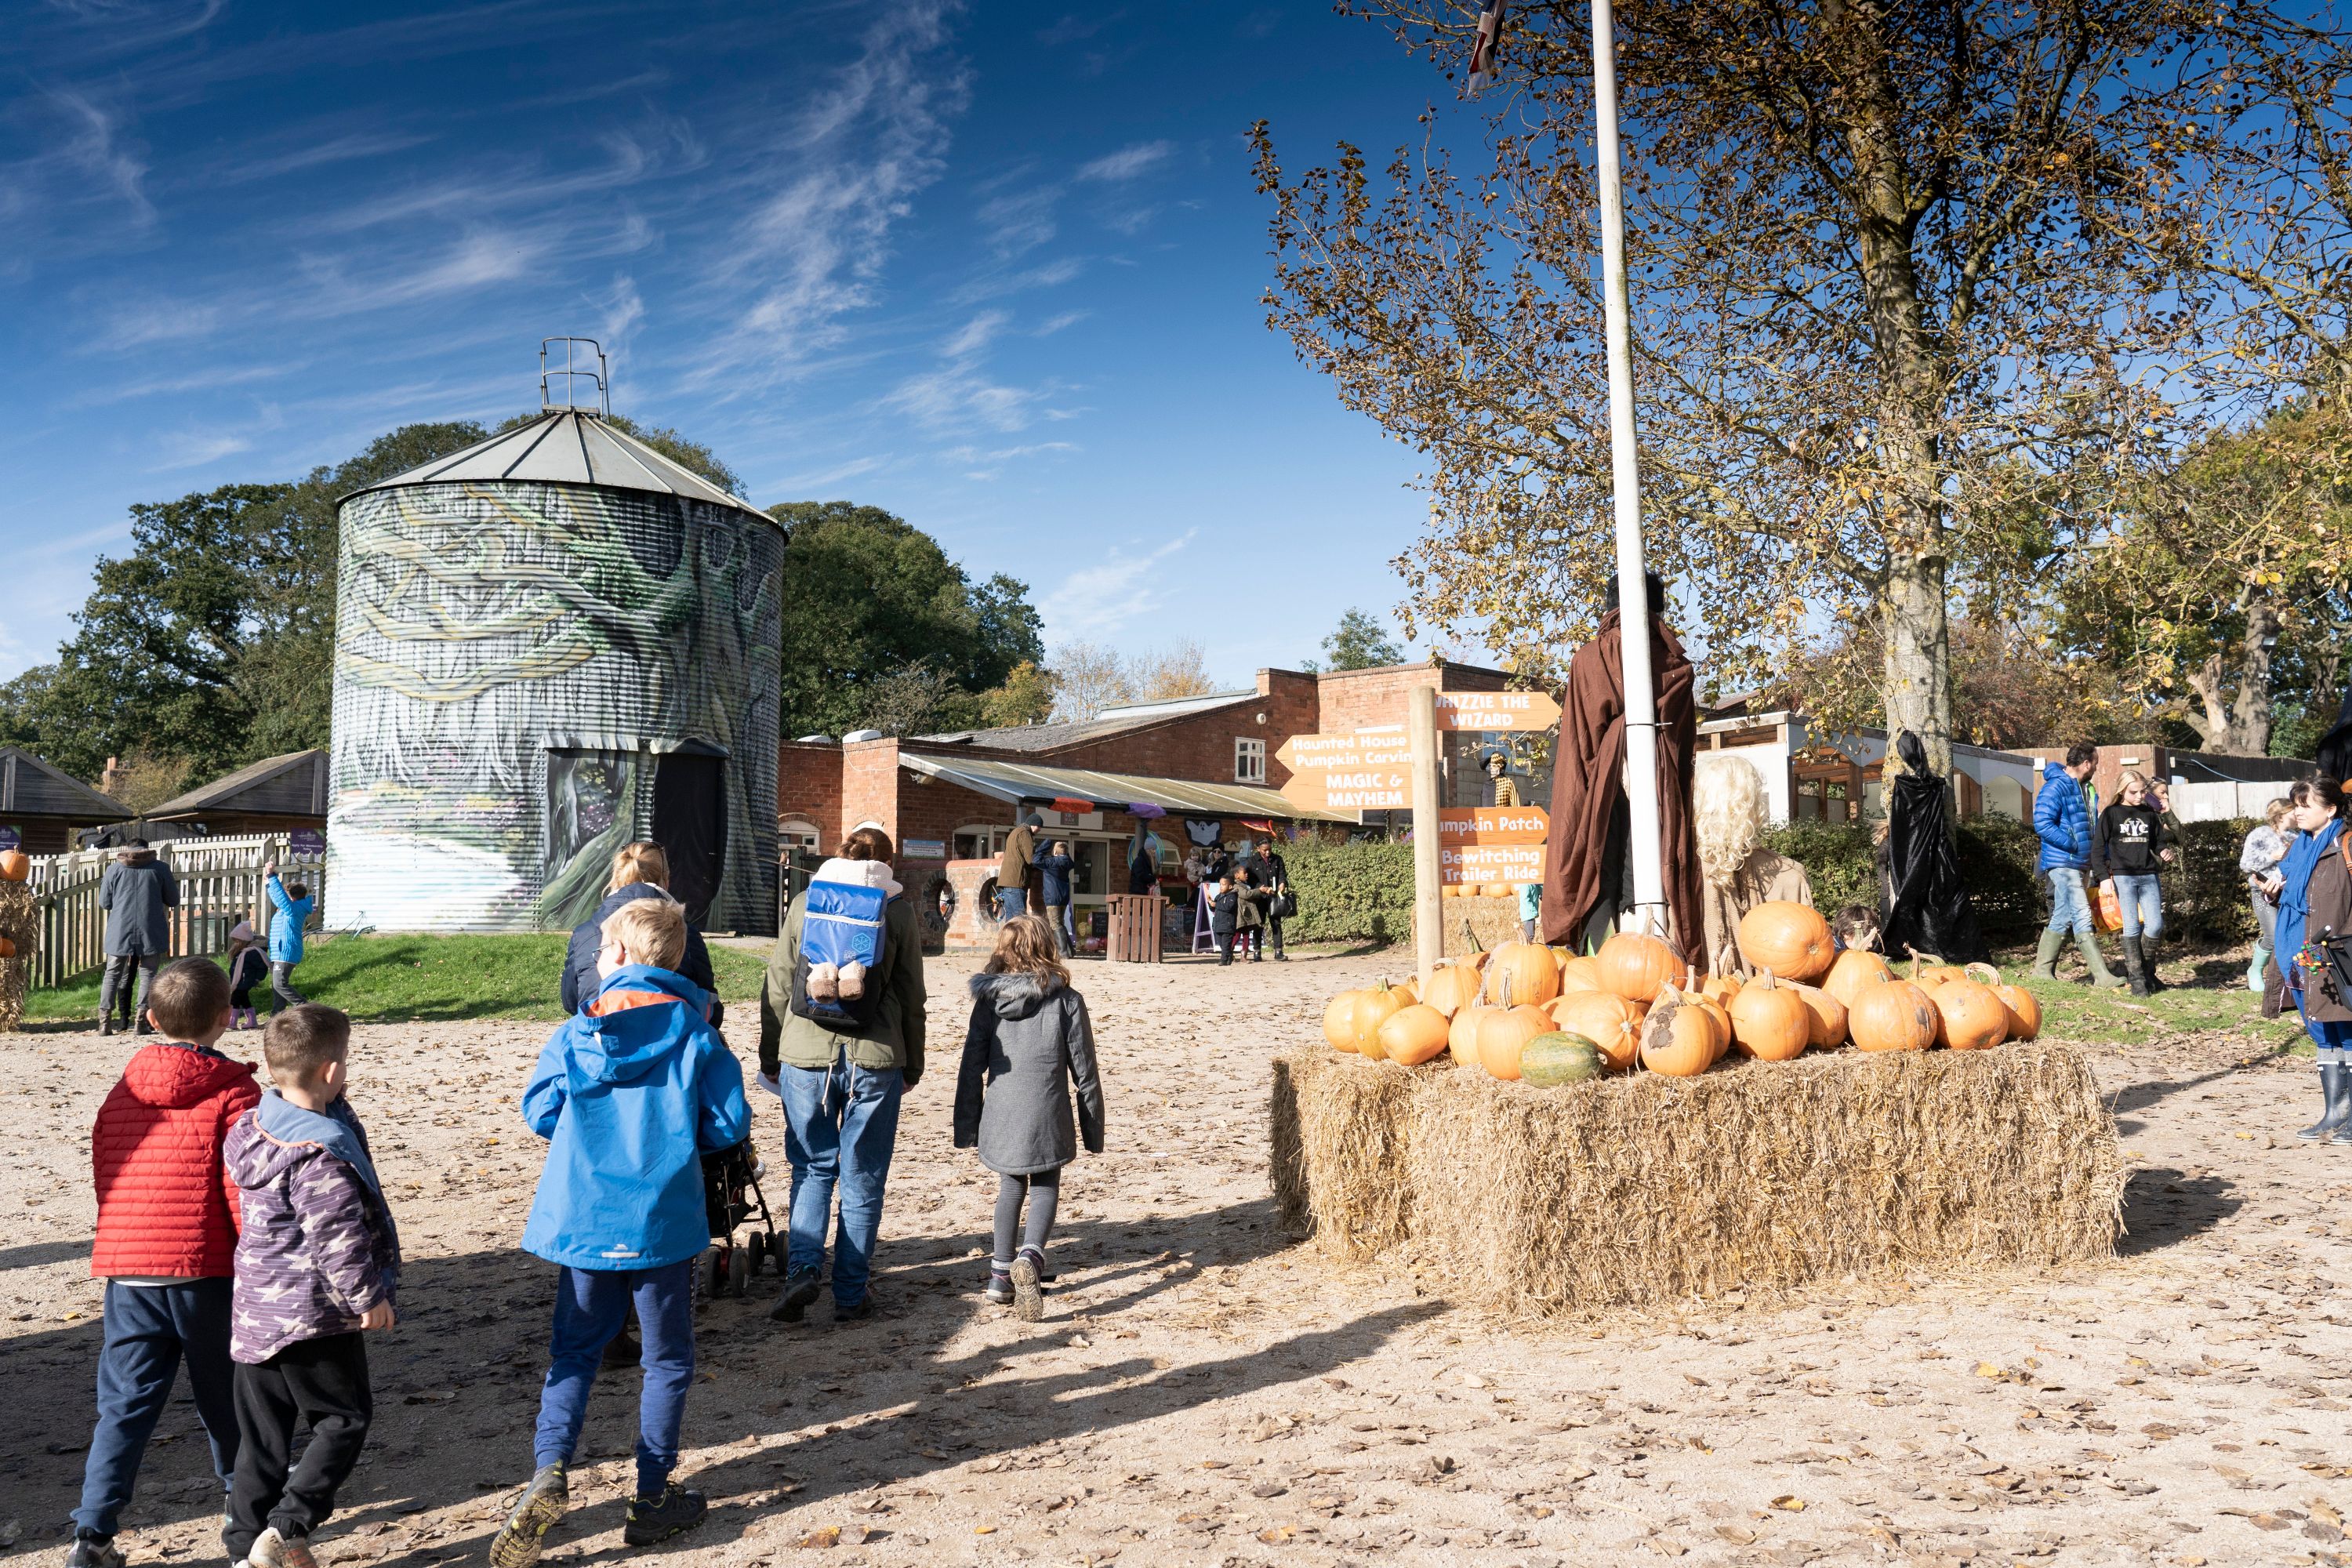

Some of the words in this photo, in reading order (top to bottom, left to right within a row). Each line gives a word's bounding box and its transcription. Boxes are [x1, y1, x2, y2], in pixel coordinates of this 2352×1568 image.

[1501, 695, 1530, 709] THE
[1450, 712, 1513, 728] WIZARD
[1292, 737, 1354, 750] Haunted
[1360, 736, 1407, 747] House
[1295, 753, 1360, 769] Pumpkin
[1365, 750, 1411, 764] Carvin
[1326, 773, 1383, 789] MAGIC
[1389, 774, 1403, 787] &
[1327, 790, 1403, 807] MAYHEM
[1439, 816, 1494, 837] mpkin
[1499, 816, 1544, 831] Patch
[2119, 820, 2149, 837] NYC
[1442, 848, 1541, 865] Bewitching
[1443, 866, 1497, 882] Trailer
[1504, 866, 1539, 880] Ride
